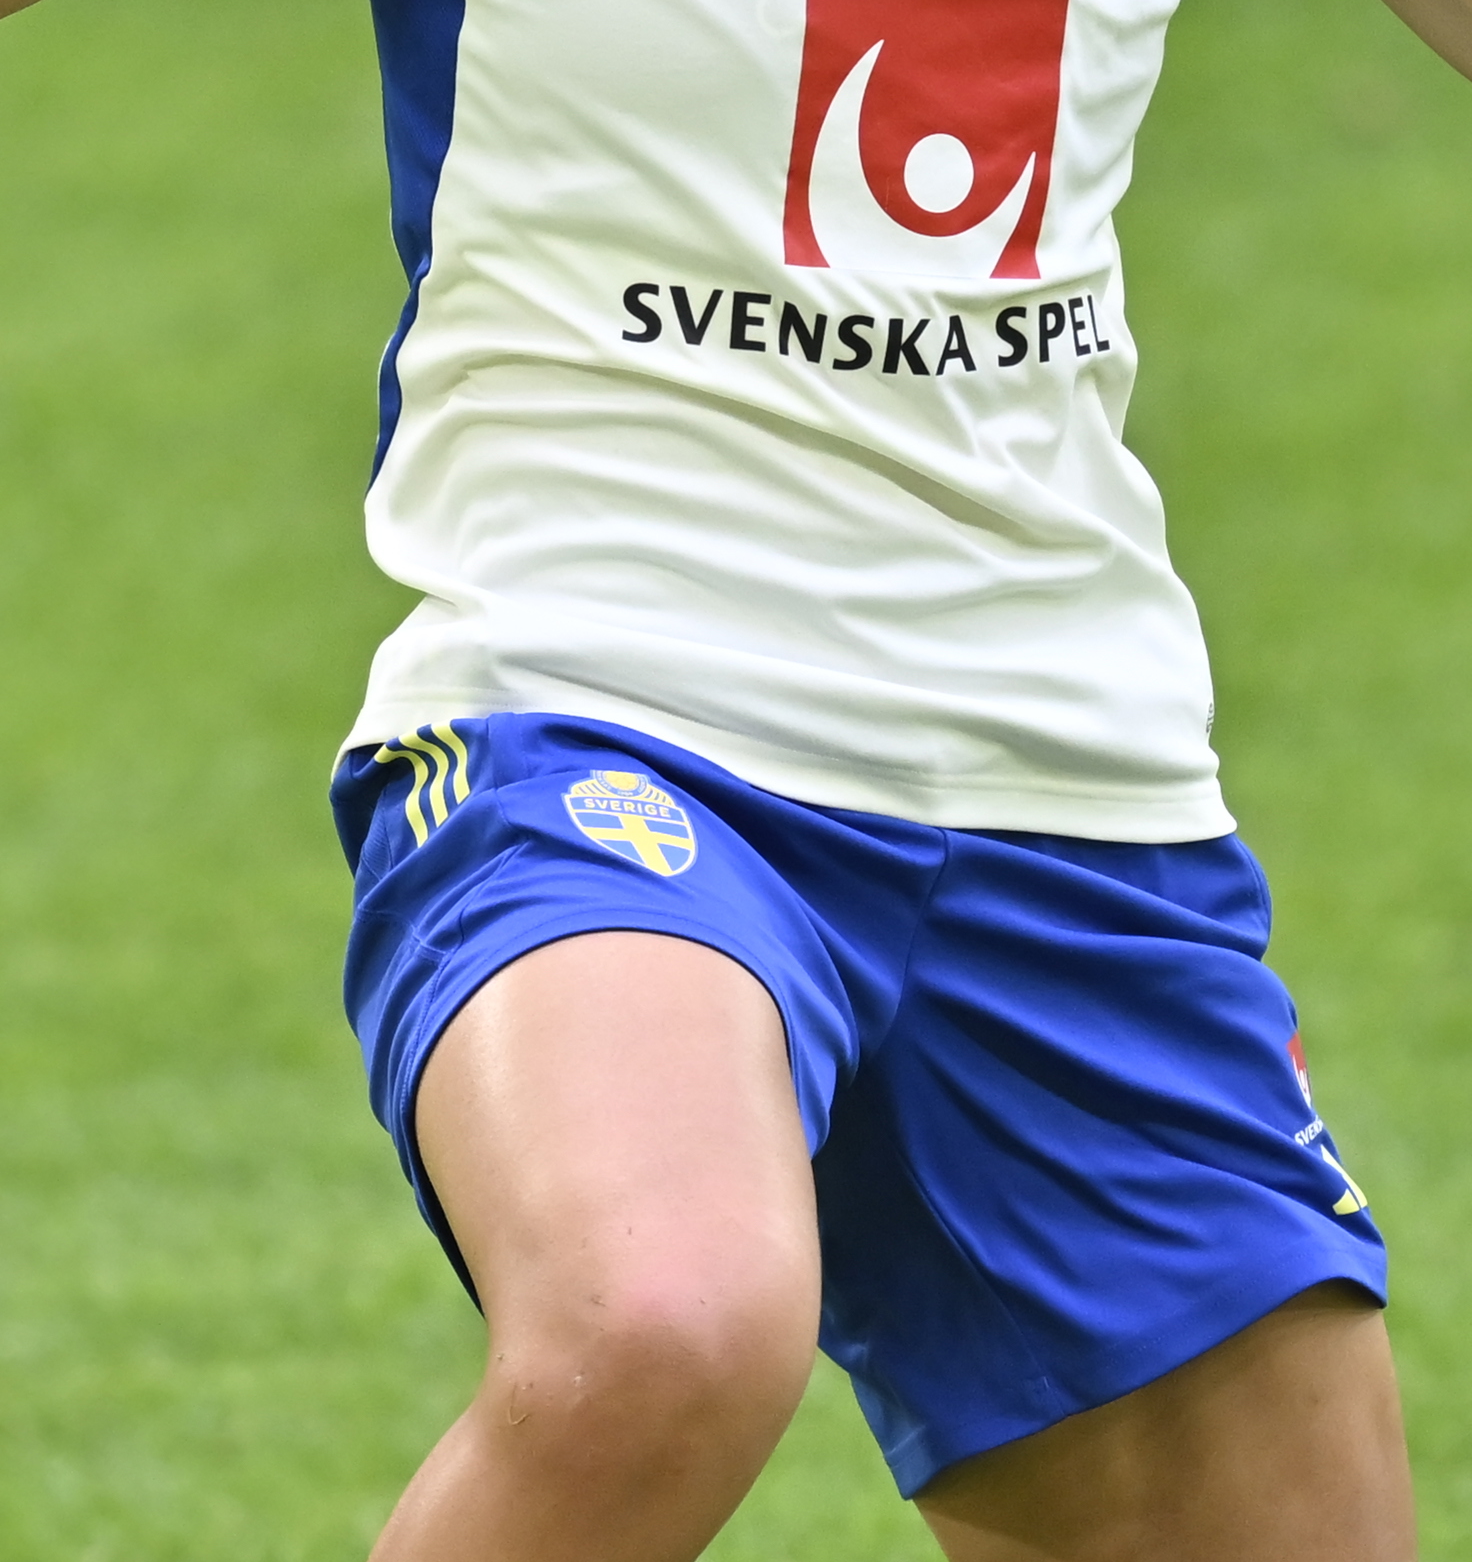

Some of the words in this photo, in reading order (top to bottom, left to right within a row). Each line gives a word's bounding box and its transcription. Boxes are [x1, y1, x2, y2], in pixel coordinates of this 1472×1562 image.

[621, 282, 977, 376] SVENSKA
[994, 294, 1111, 368] SPEL
[583, 798, 672, 818] SVERIGE
